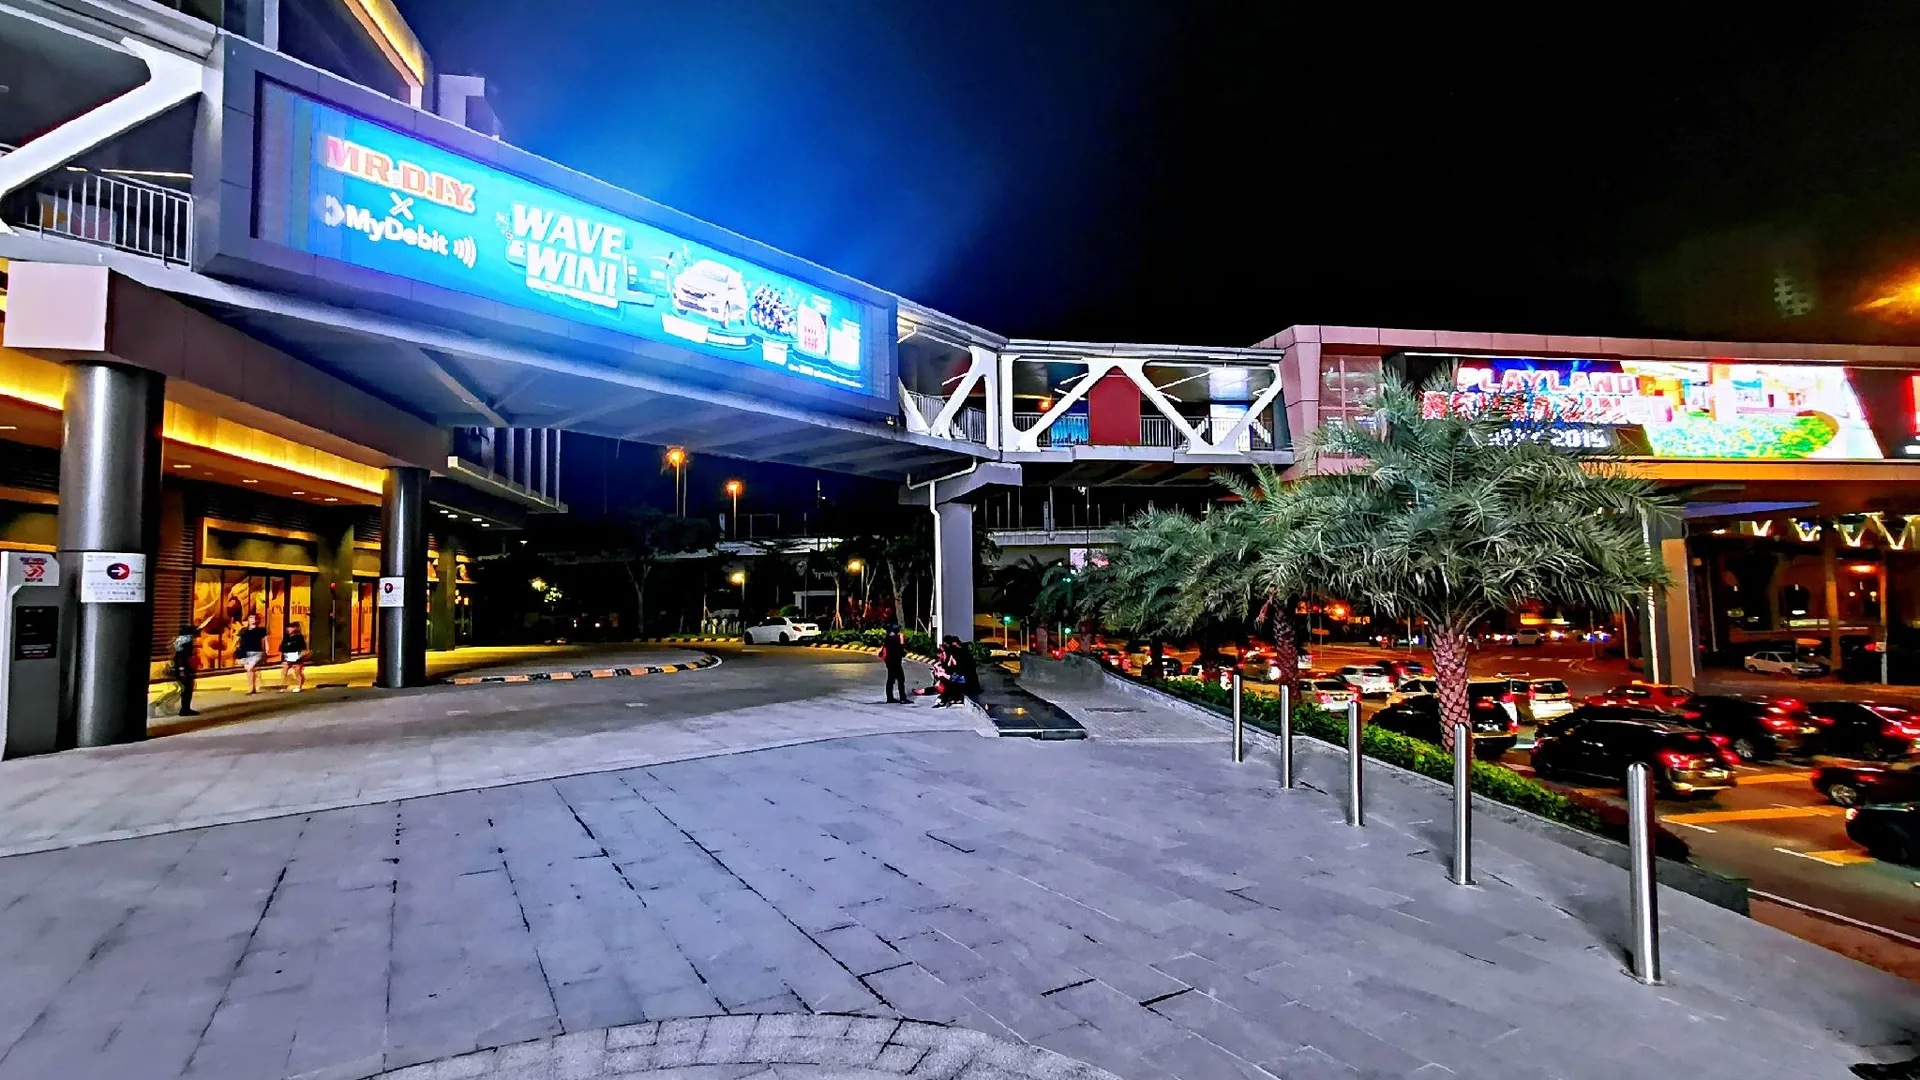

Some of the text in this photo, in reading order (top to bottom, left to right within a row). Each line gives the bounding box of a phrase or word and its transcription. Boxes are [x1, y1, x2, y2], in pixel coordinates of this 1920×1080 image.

[345, 203, 449, 256] MyDebit
[512, 203, 624, 261] WAVE
[1456, 367, 1640, 394] PLAYLAND
